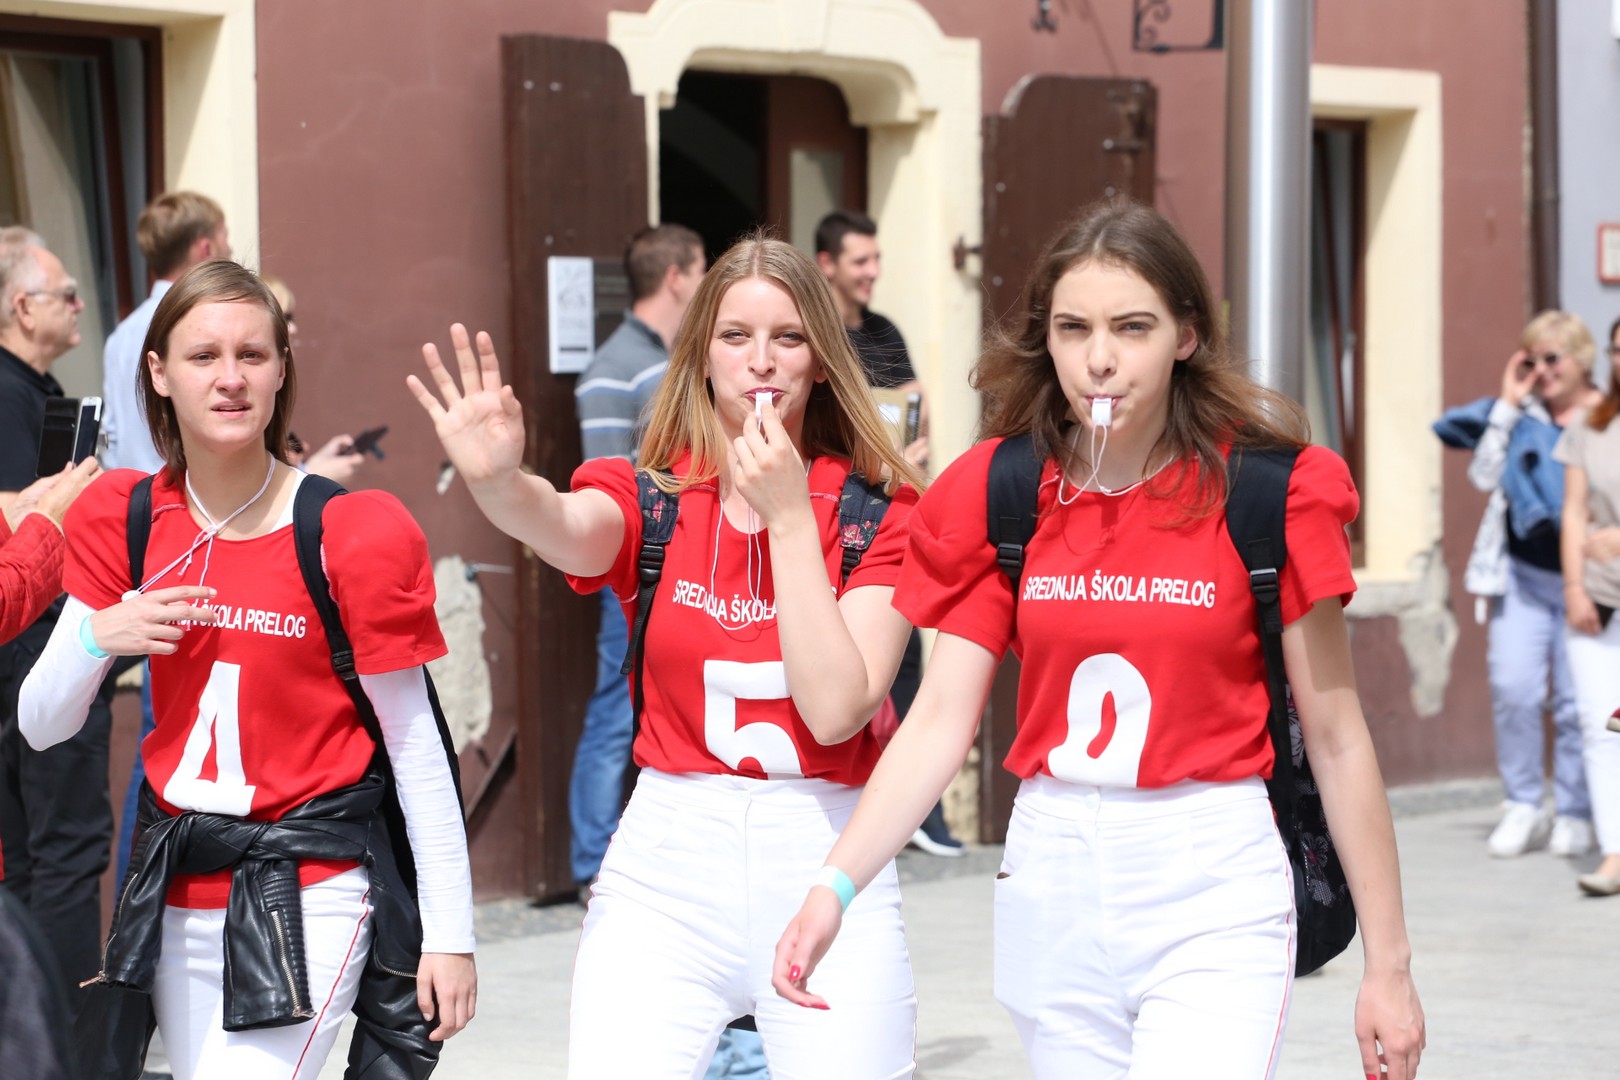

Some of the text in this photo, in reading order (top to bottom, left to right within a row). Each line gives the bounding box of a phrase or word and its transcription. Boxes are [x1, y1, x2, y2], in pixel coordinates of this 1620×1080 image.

[672, 579, 728, 621] SREDNJA
[1023, 569, 1216, 609] SREDNJA ŠKOLA PRELOG
[245, 609, 306, 639] PRELOG
[704, 659, 805, 780] 5
